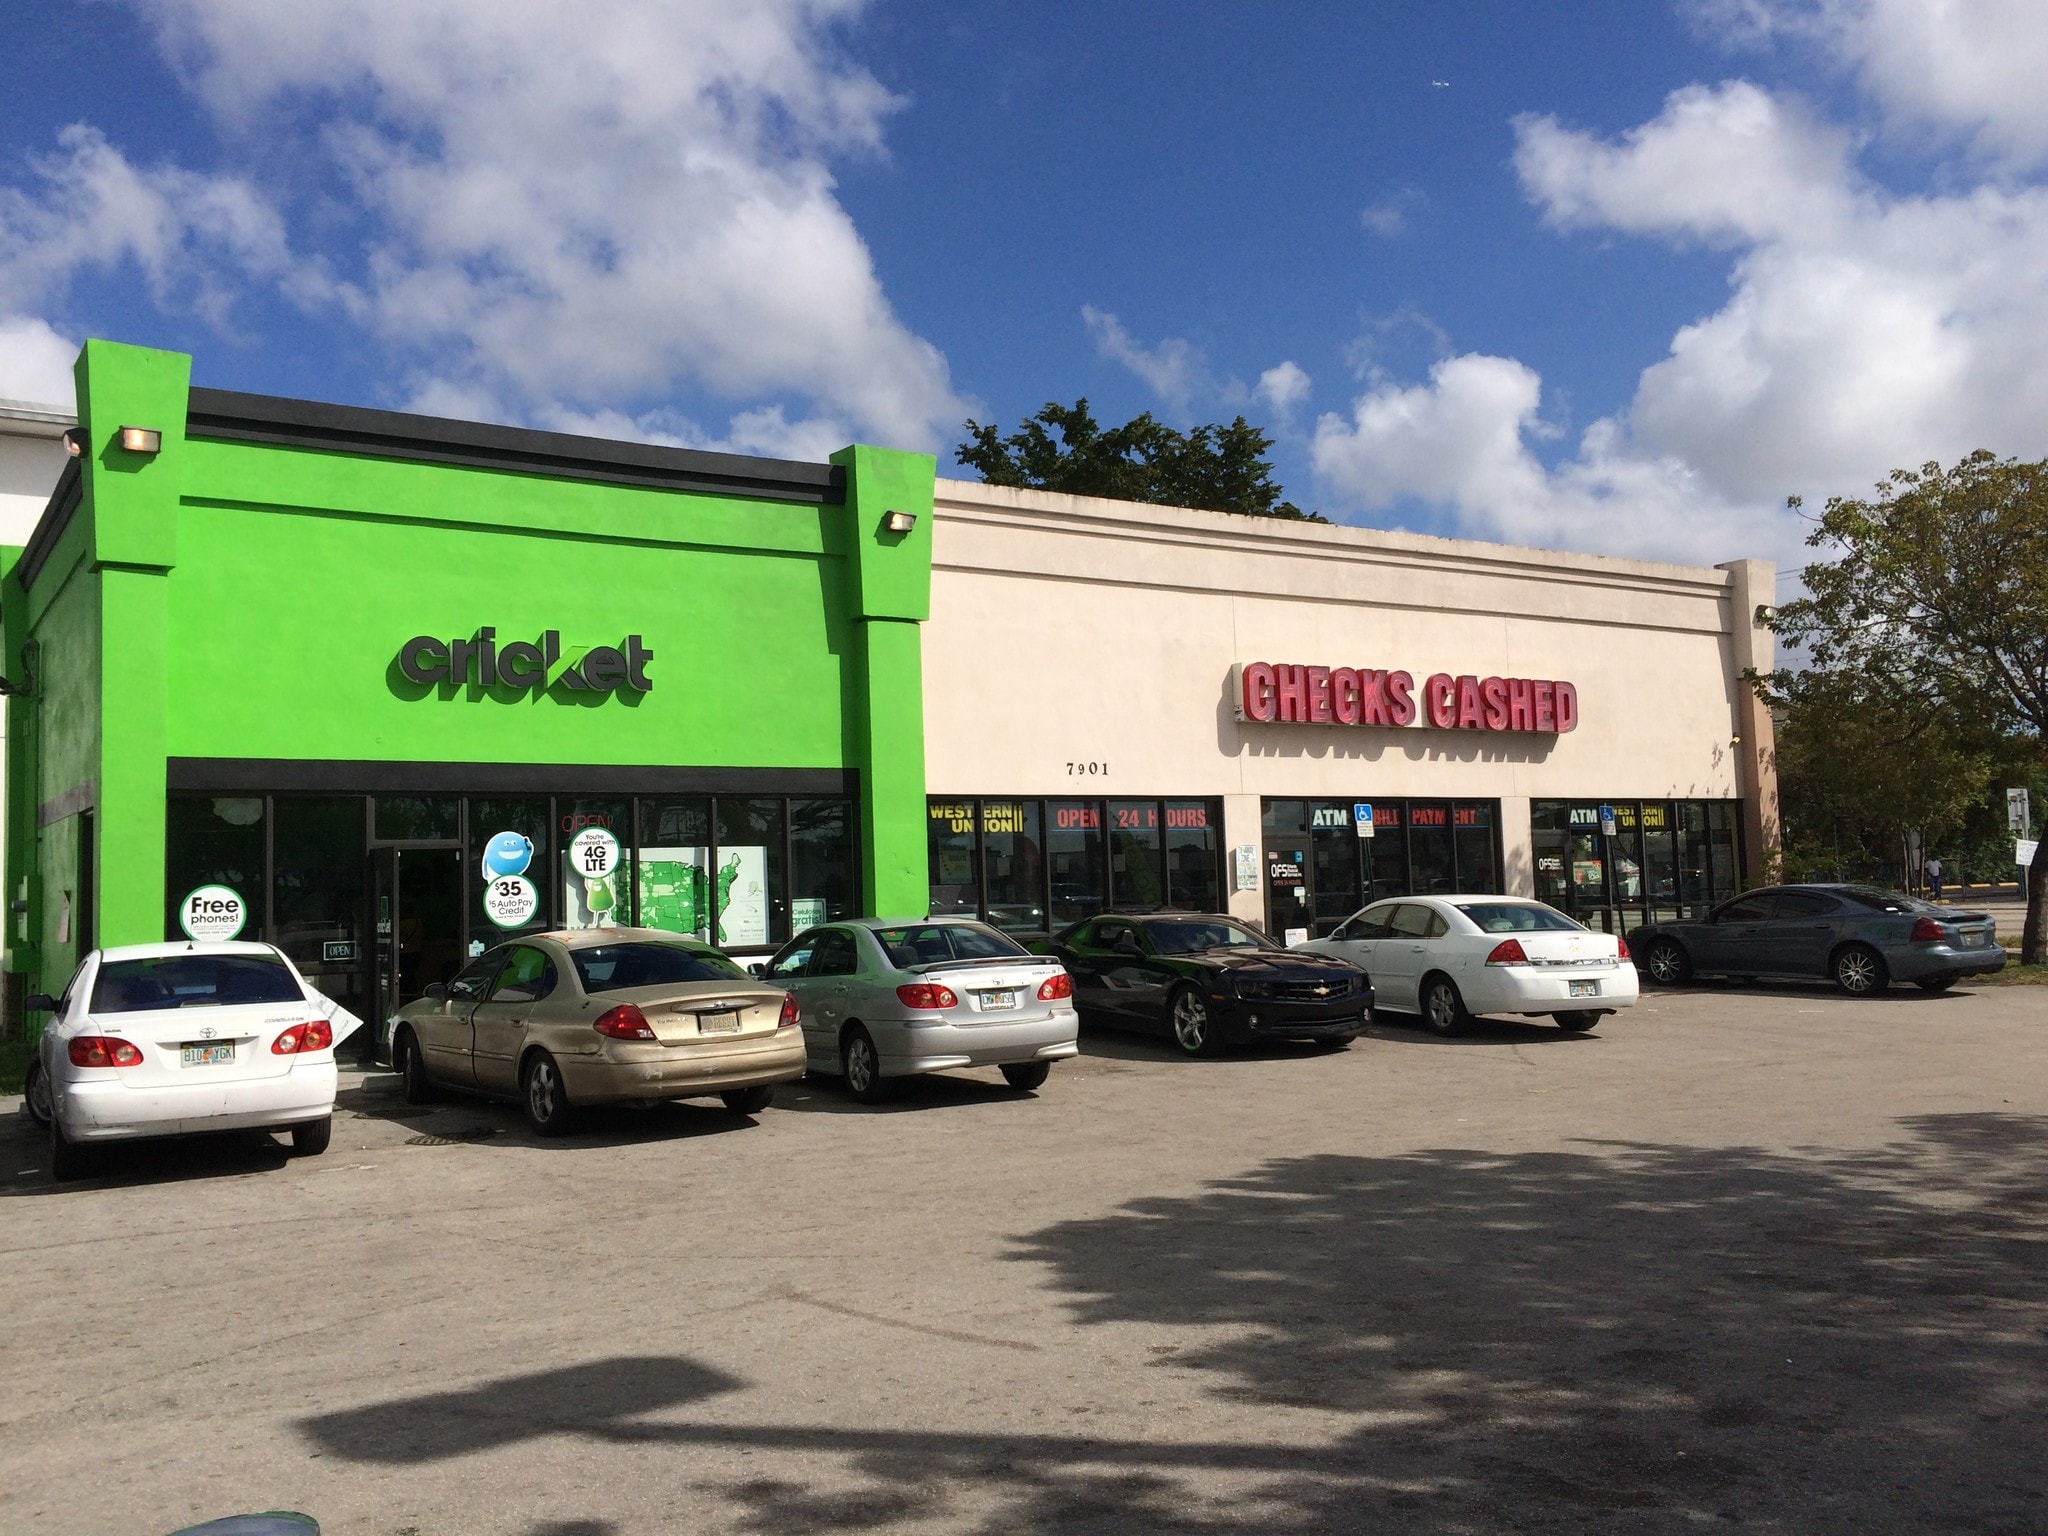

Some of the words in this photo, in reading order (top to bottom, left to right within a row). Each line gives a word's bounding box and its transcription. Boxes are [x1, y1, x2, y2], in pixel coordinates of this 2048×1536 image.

[400, 626, 654, 692] cricket
[1243, 662, 1416, 727] CHECKS
[1426, 673, 1578, 734] CASHED
[1066, 762, 1109, 776] 7901
[930, 805, 1013, 819] WESTERN
[1057, 808, 1098, 828] OPEN
[1118, 808, 1140, 828] 24
[1148, 808, 1207, 828] HOURS
[1313, 809, 1348, 826] ATM
[1373, 808, 1399, 826] BILL
[1412, 808, 1475, 825] PAYMENT
[1569, 809, 1598, 824] ATM
[951, 819, 1013, 833] UNION
[584, 846, 606, 858] 4G
[585, 859, 606, 871] LTE
[1271, 864, 1288, 877] OFS
[495, 881, 522, 897] $35
[191, 896, 239, 913] Free
[497, 899, 517, 908] Auto
[518, 899, 534, 907] Pay
[499, 906, 524, 915] Credit
[191, 913, 239, 926] phones!
[792, 914, 823, 928] gratis!
[329, 945, 350, 956] OPEN
